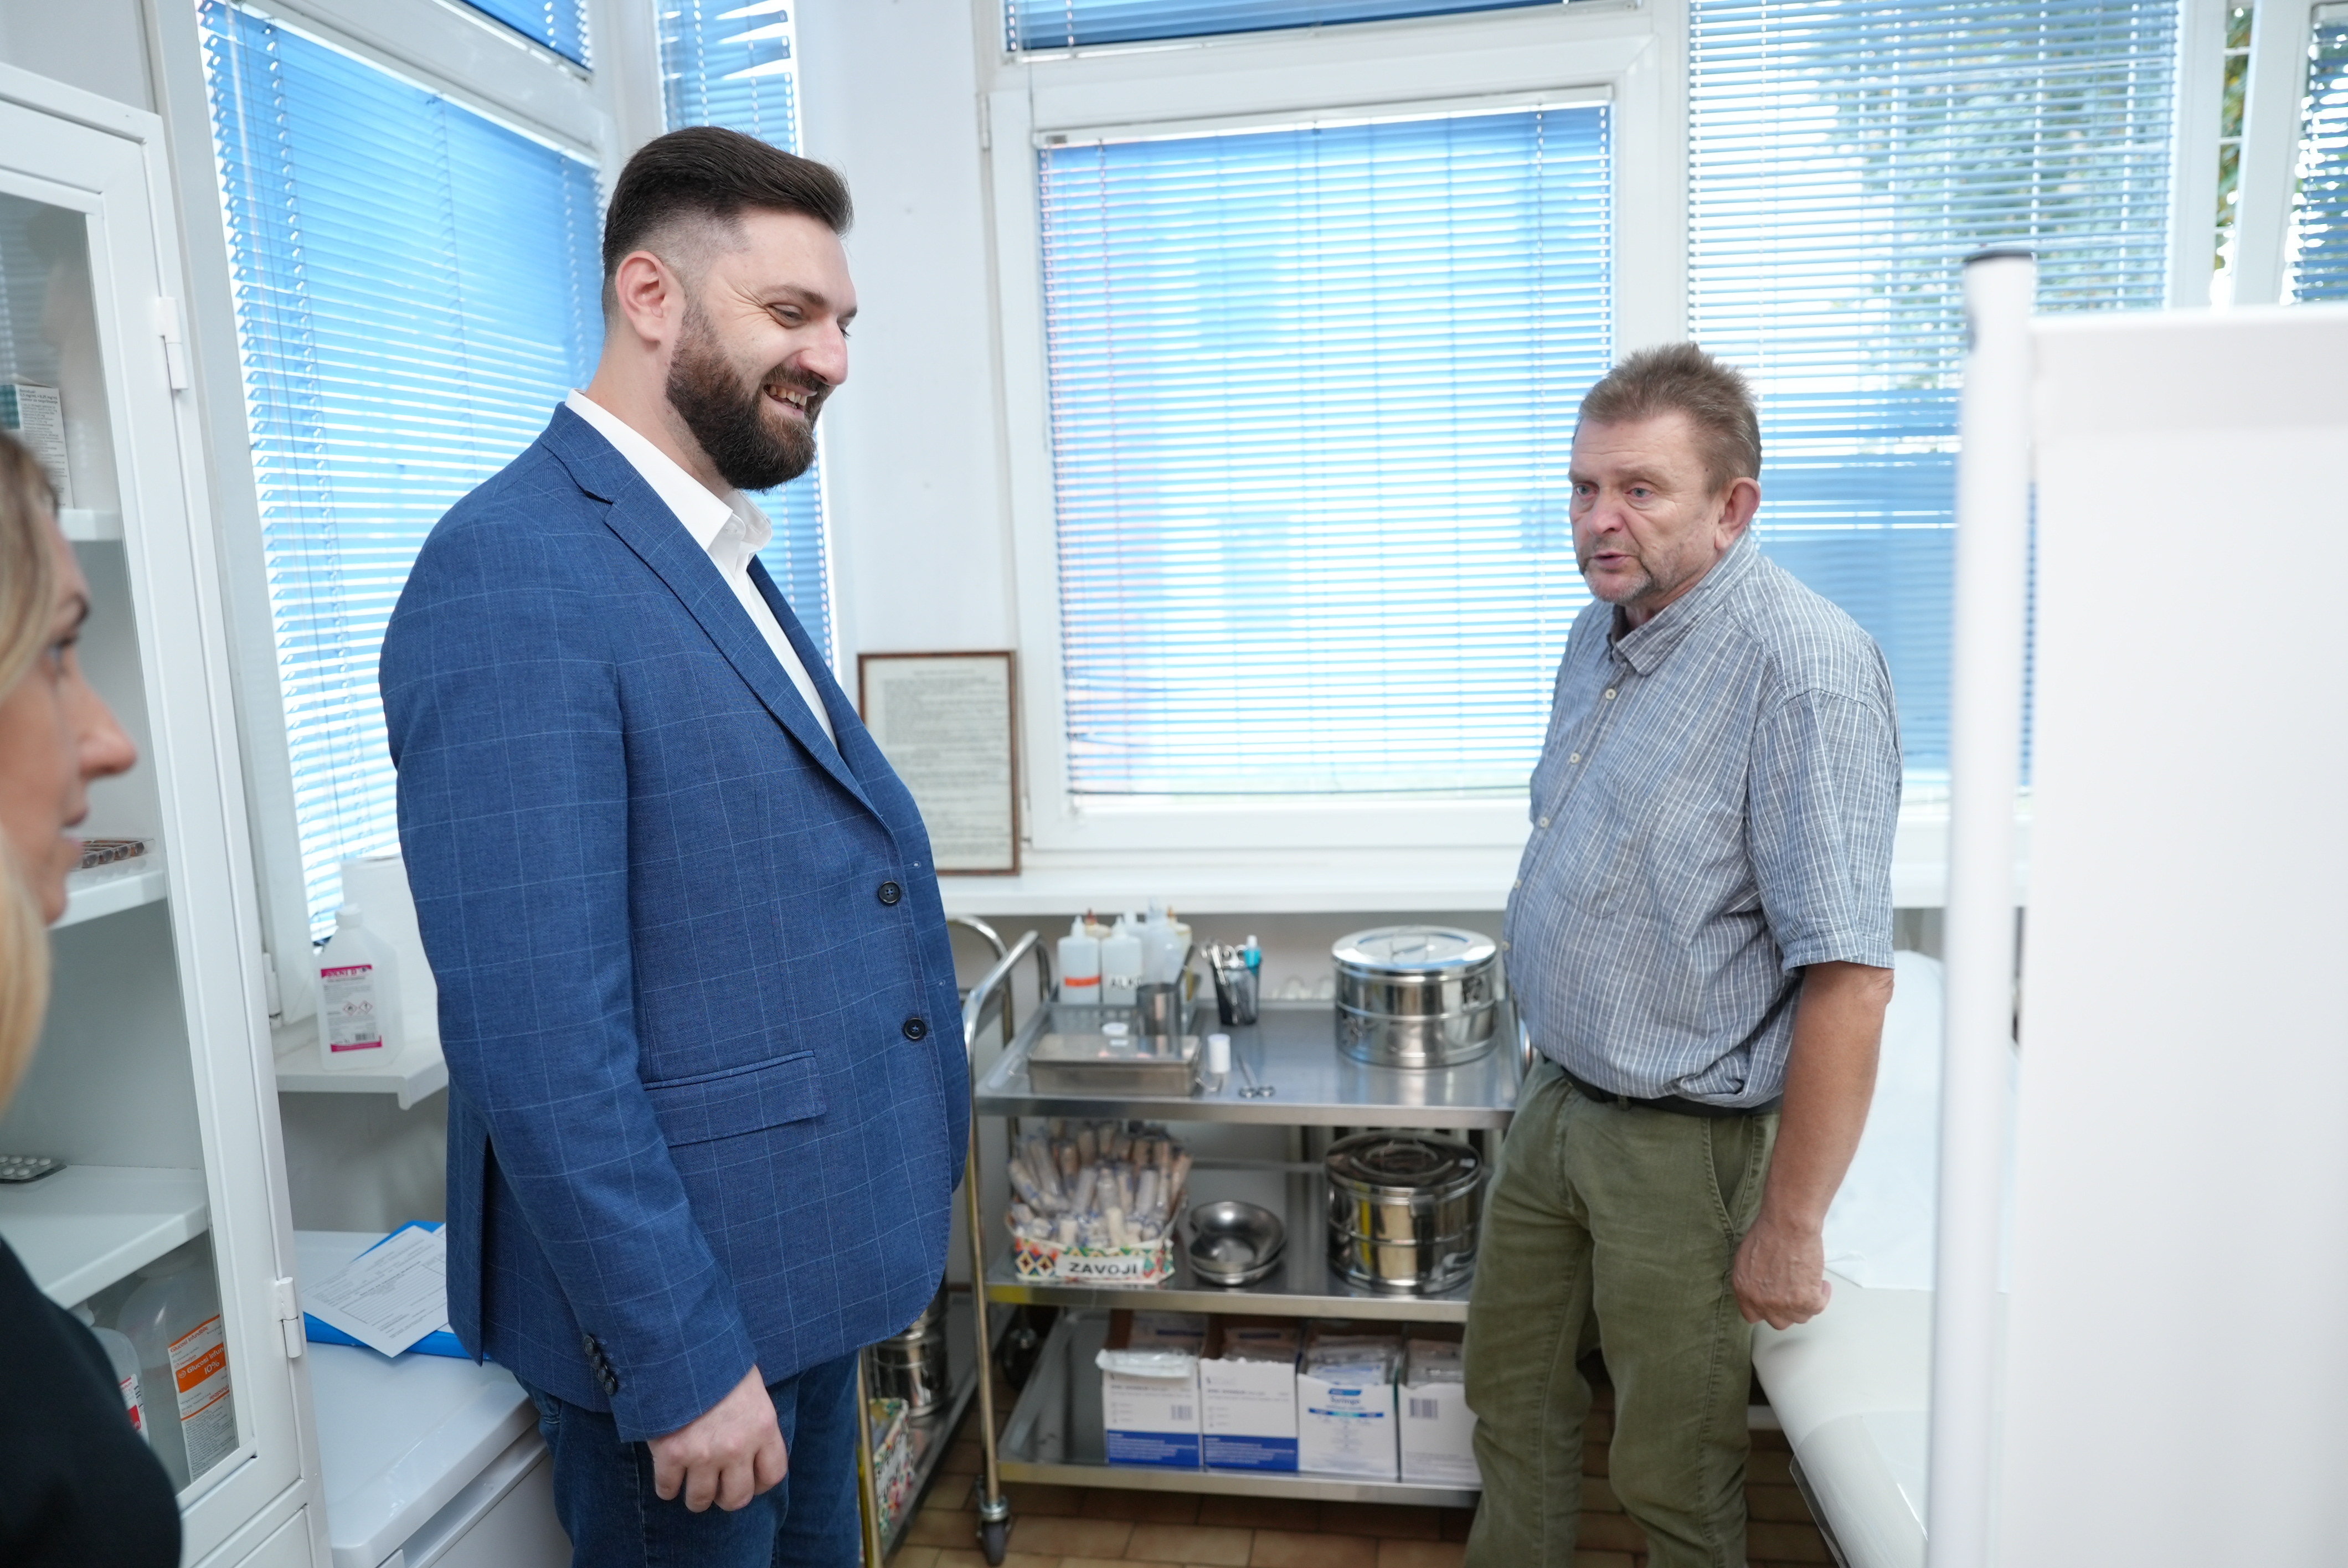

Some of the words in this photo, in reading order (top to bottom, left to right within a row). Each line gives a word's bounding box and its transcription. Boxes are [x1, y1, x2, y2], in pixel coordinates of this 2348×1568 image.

[1069, 1262, 1137, 1274] ZAVOJI
[170, 1339, 188, 1353] Glucosi
[187, 1355, 210, 1374] Glucosi
[204, 1360, 220, 1375] 10%
